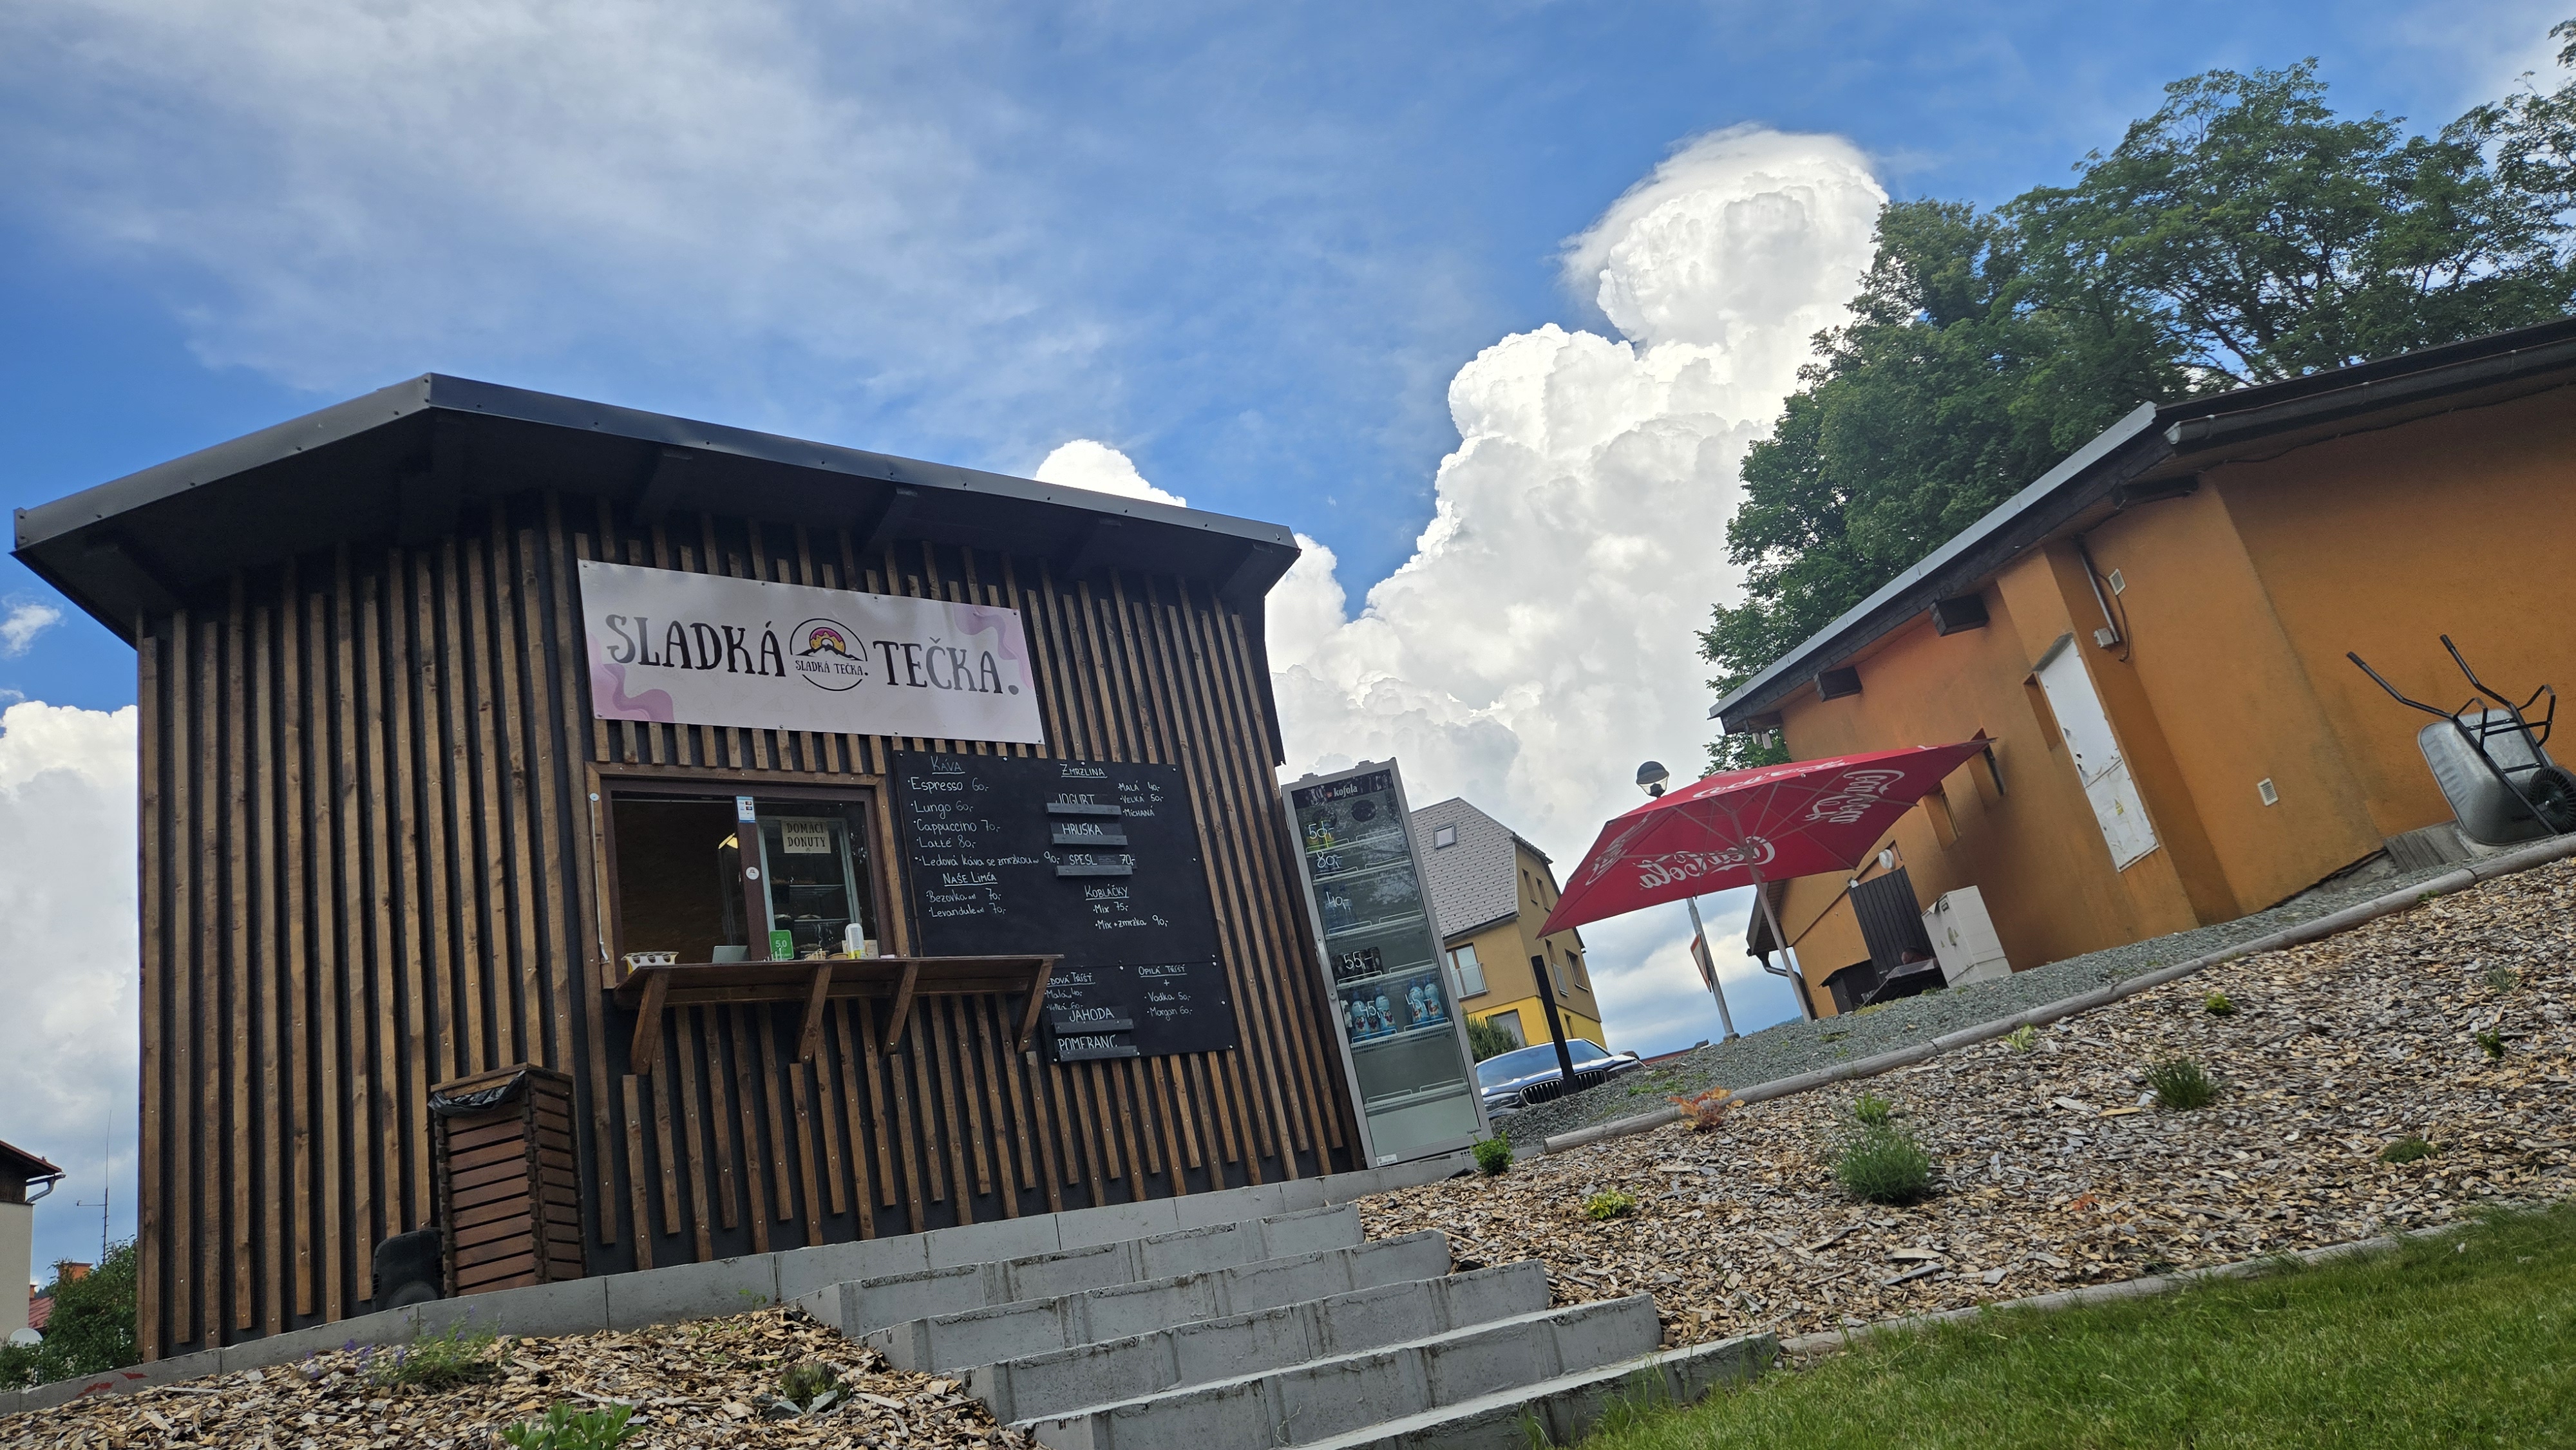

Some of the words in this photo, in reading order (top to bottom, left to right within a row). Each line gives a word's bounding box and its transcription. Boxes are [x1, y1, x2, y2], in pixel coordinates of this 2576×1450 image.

[605, 614, 787, 677] SLADKÁ
[873, 636, 1019, 695] TEČKA.
[795, 661, 830, 673] SLADKÁ
[833, 663, 869, 676] TEČKA.
[1059, 763, 1106, 777] ZMRZLINA
[911, 777, 963, 795] Espresso
[1119, 780, 1140, 791] MALÁ
[1333, 784, 1358, 798] kofola
[1056, 793, 1095, 805] JOGURT
[914, 800, 952, 820] Lungo
[916, 818, 977, 835] Cappuccino
[787, 836, 826, 847] DONUTY
[922, 853, 958, 867] Ledová
[986, 858, 996, 867] se
[942, 872, 969, 884] NAŠE
[930, 903, 977, 918] Levandule
[1094, 903, 1110, 914] Mix
[1097, 919, 1112, 930] Mix
[775, 939, 788, 948] 5,0
[1138, 965, 1161, 975] OPILÁ
[1147, 992, 1175, 1002] Vodka
[1068, 1007, 1115, 1022] JAHODA
[1149, 1006, 1178, 1022] Morgan
